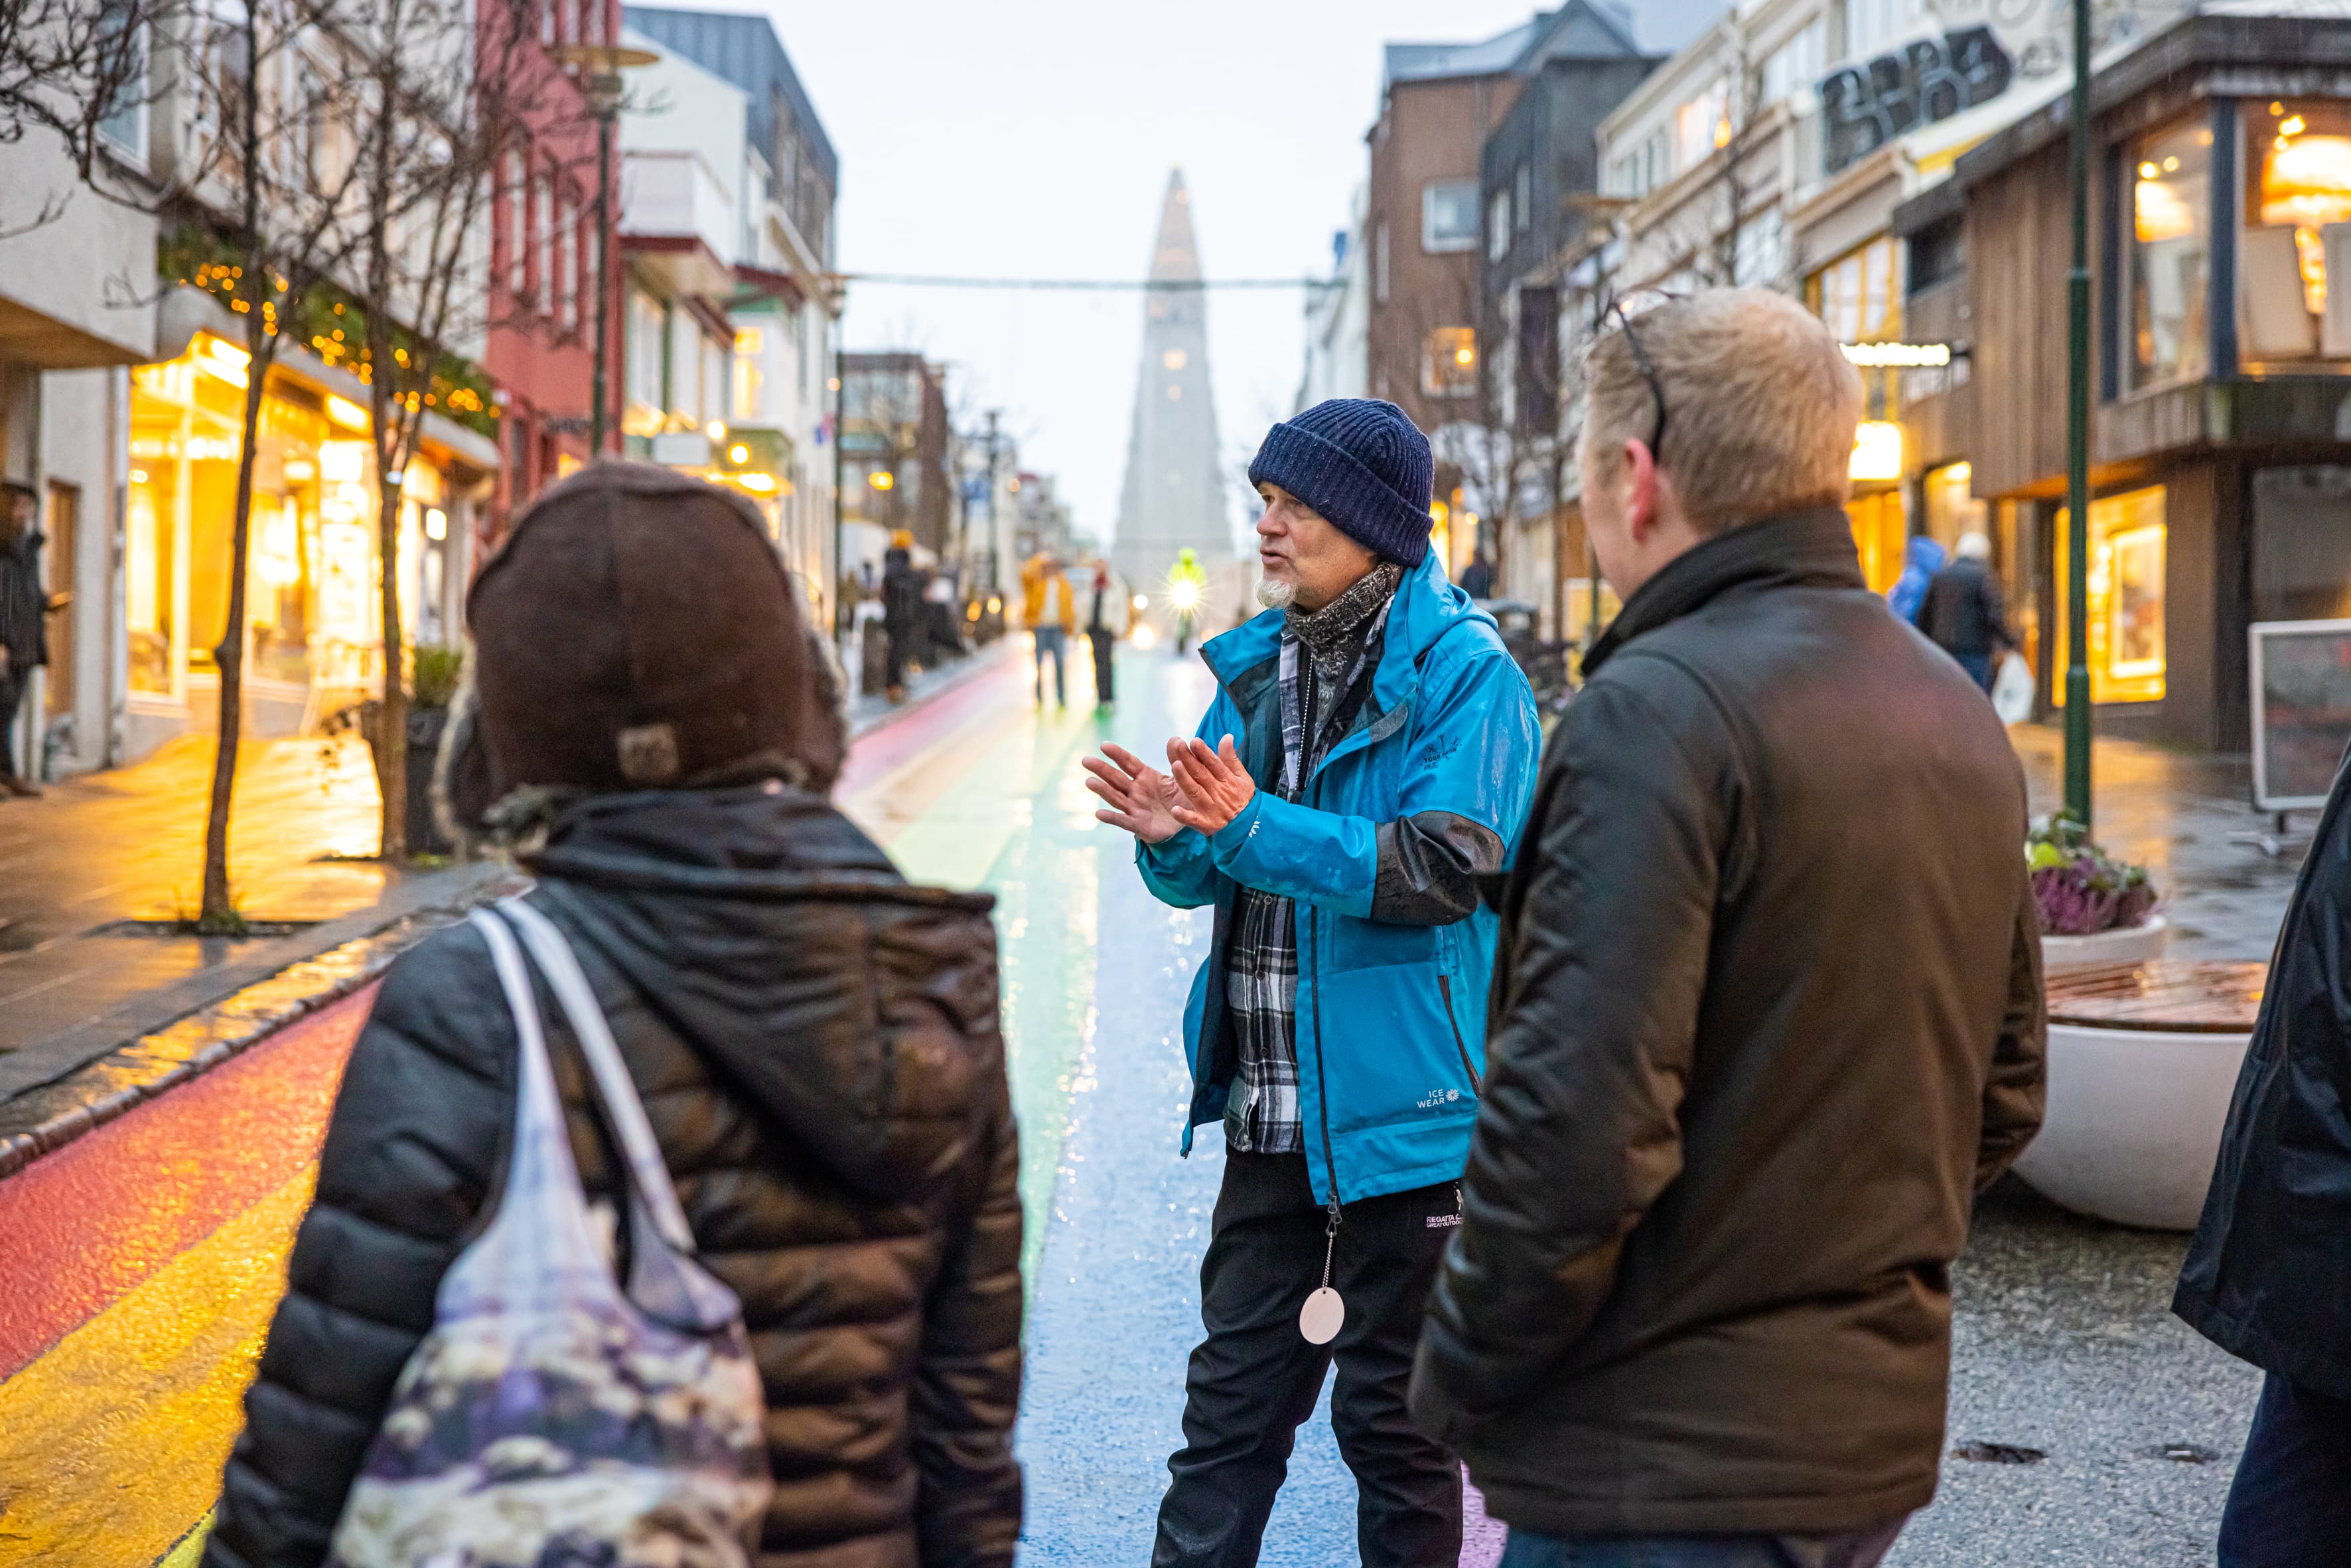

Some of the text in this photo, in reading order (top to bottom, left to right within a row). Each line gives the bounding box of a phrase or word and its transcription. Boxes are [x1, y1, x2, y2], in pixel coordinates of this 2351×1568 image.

[1429, 1089, 1444, 1098] ICE
[1417, 1098, 1445, 1108] WEAR
[1427, 1214, 1455, 1223] REGATTA
